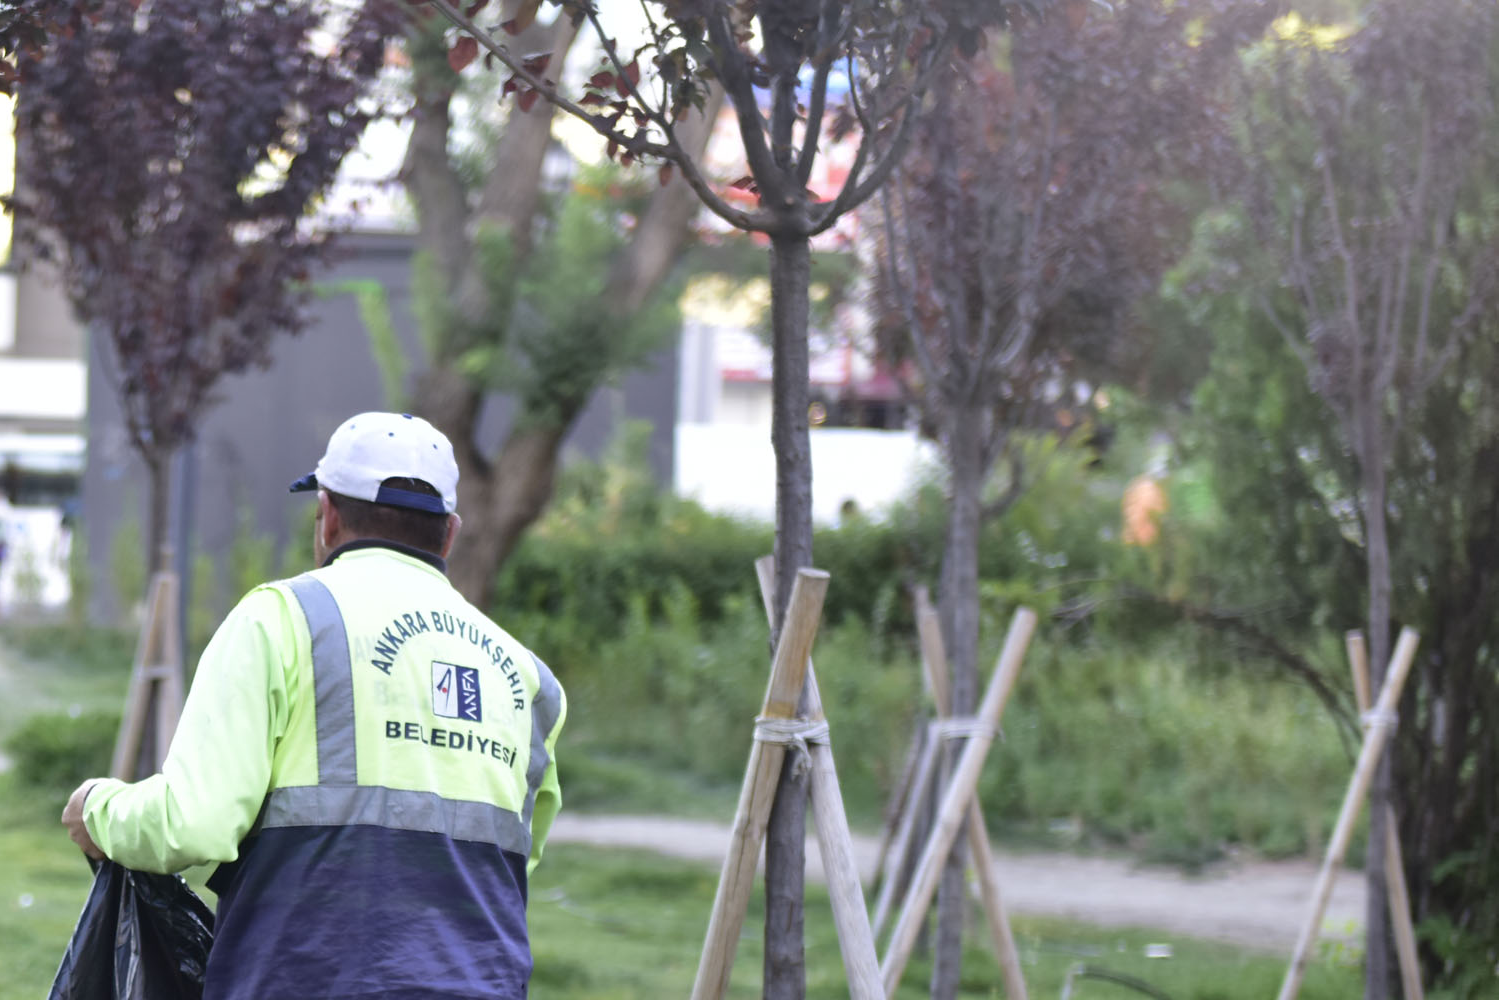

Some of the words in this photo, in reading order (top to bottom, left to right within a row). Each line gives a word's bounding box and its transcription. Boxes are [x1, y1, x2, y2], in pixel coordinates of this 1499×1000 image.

[371, 610, 431, 675] ANKARA
[462, 670, 478, 720] ANFA
[385, 720, 517, 768] BELEDİYESİ
